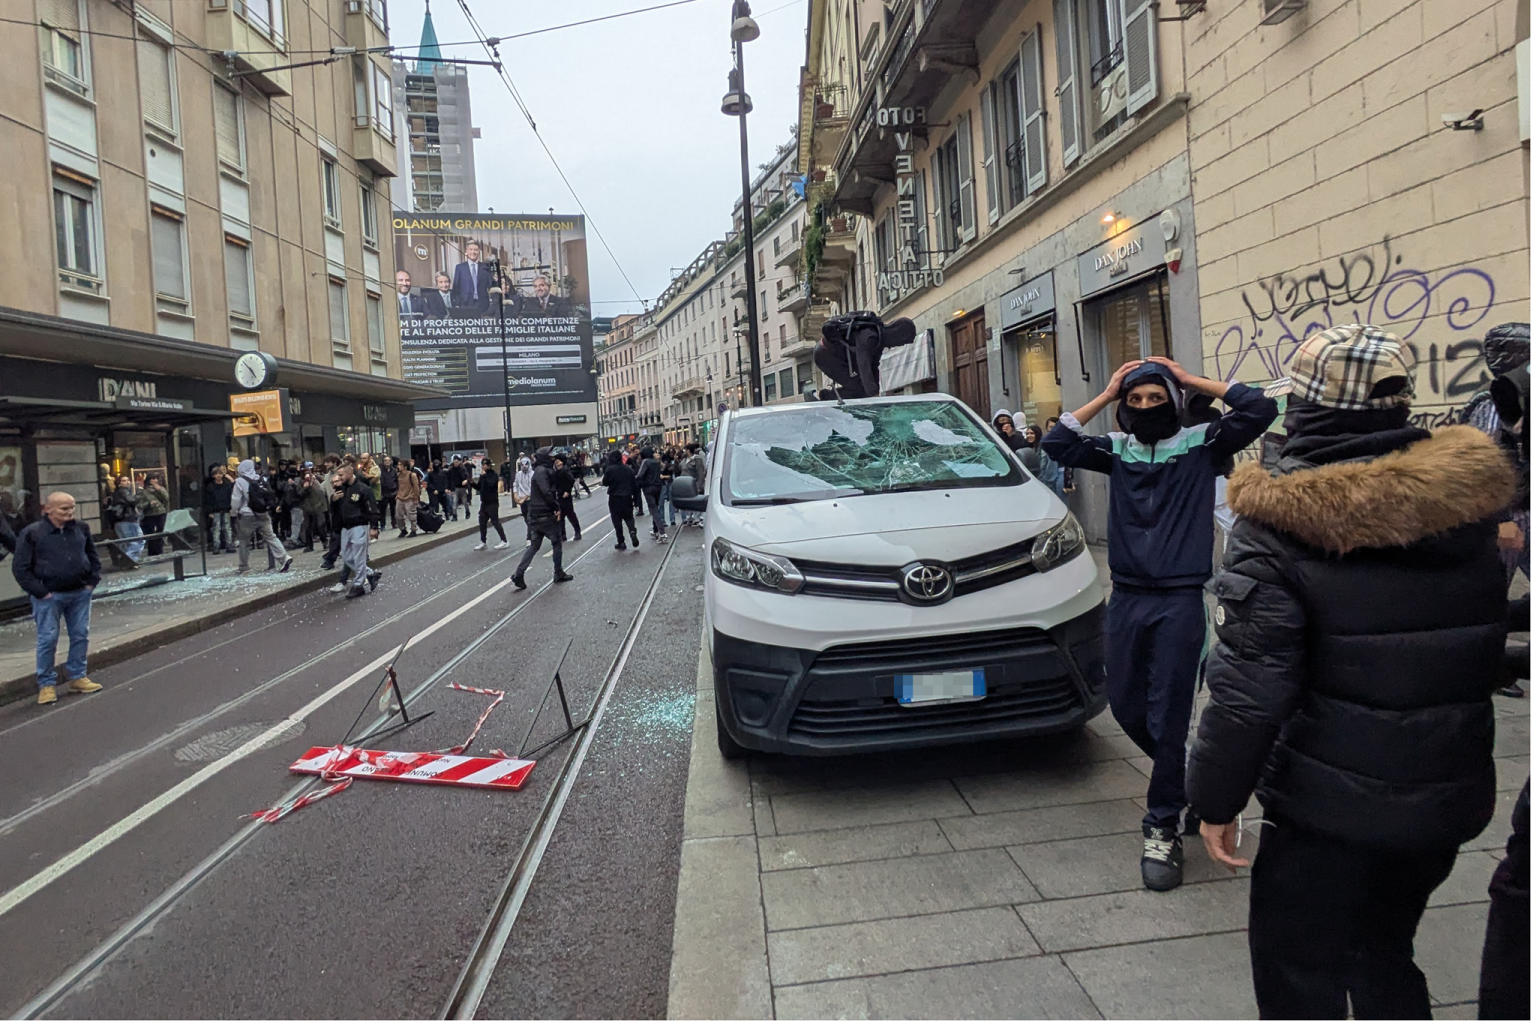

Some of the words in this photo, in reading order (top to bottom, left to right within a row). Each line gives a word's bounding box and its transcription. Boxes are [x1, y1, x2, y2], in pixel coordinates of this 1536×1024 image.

[393, 218, 450, 230] OLANUM
[454, 219, 504, 231] GRANDI
[507, 220, 574, 231] PATRIMONI
[1094, 254, 1114, 272] DAN
[1114, 237, 1145, 265] JOHN
[411, 319, 421, 327] DI
[423, 318, 497, 328] PROFESSIONISTI
[521, 317, 580, 326] COMPETENZE
[412, 328, 425, 336] AL
[427, 327, 463, 336] FIANCO
[465, 326, 493, 335] DELLE
[537, 325, 577, 334] ITALIANE
